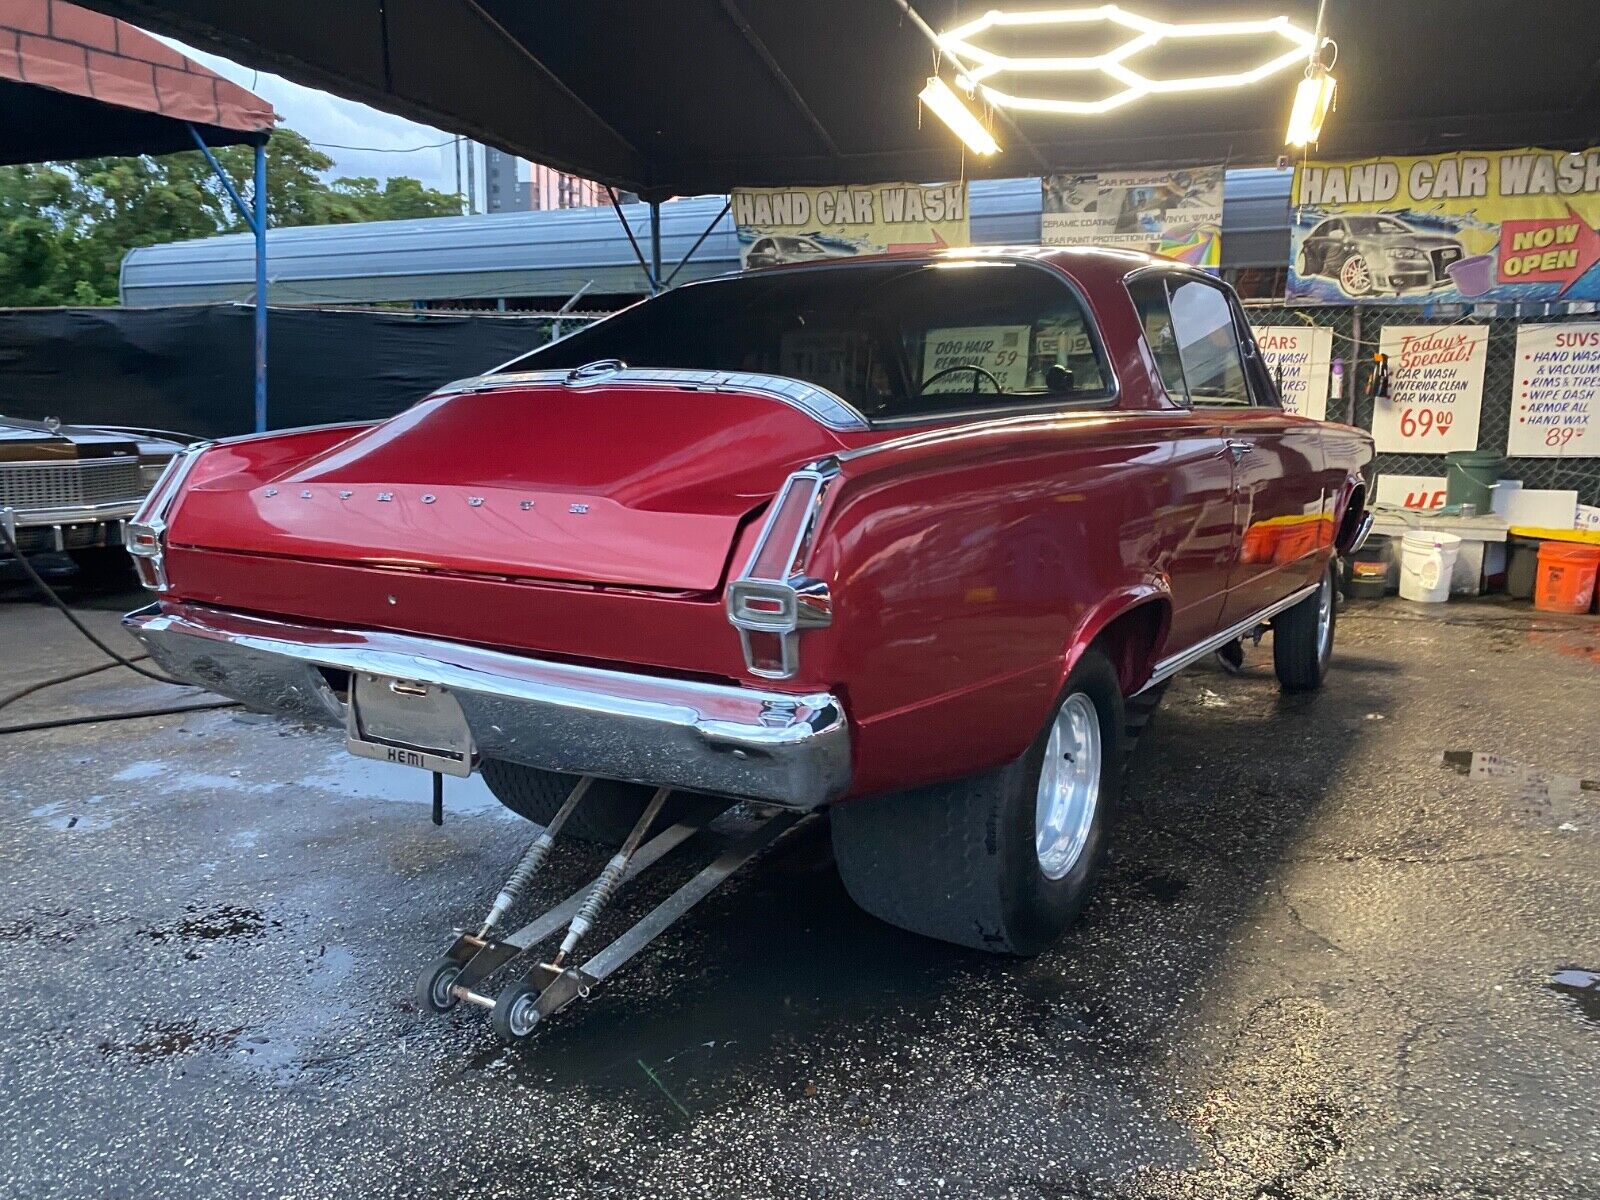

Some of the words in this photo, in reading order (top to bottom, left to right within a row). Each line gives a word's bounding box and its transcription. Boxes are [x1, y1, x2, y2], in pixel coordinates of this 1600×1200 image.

[1303, 162, 1400, 205] HAND
[1408, 156, 1490, 200] CAR
[735, 193, 811, 226] HAND
[816, 190, 875, 226] CAR
[881, 187, 965, 224] WASH
[1043, 220, 1079, 229] CERAMIC
[1081, 217, 1117, 227] COATING
[1165, 215, 1189, 223] VINYL
[1193, 213, 1222, 221] WRAP
[1067, 235, 1089, 244] PAINT
[1093, 233, 1143, 243] PROTECTION
[1513, 224, 1580, 251] NOW
[1503, 250, 1579, 277] OPEN
[1259, 336, 1297, 349] CARS
[1556, 332, 1600, 347] SUVS
[935, 341, 962, 355] DOG
[963, 340, 994, 353] HAIR
[994, 350, 1018, 366] 59
[1279, 352, 1308, 363] WASH
[1534, 351, 1569, 362] HAND
[1396, 369, 1421, 379] CAR
[1424, 369, 1457, 379] WASH
[1537, 365, 1545, 375] &
[1548, 364, 1600, 375] VACUUM
[1393, 380, 1438, 391] INTERIOR
[1439, 380, 1469, 391] CLEAN
[1531, 377, 1560, 388] RIMS
[1392, 392, 1416, 403] CAR
[1418, 392, 1457, 403] WAXED
[1530, 390, 1561, 400] WIPE
[1563, 389, 1595, 400] DASH
[1528, 402, 1569, 413] ARMOR
[1571, 402, 1589, 412] ALL
[1527, 415, 1560, 425] HAND
[1564, 415, 1590, 425] WAX
[387, 747, 425, 768] HEMI
